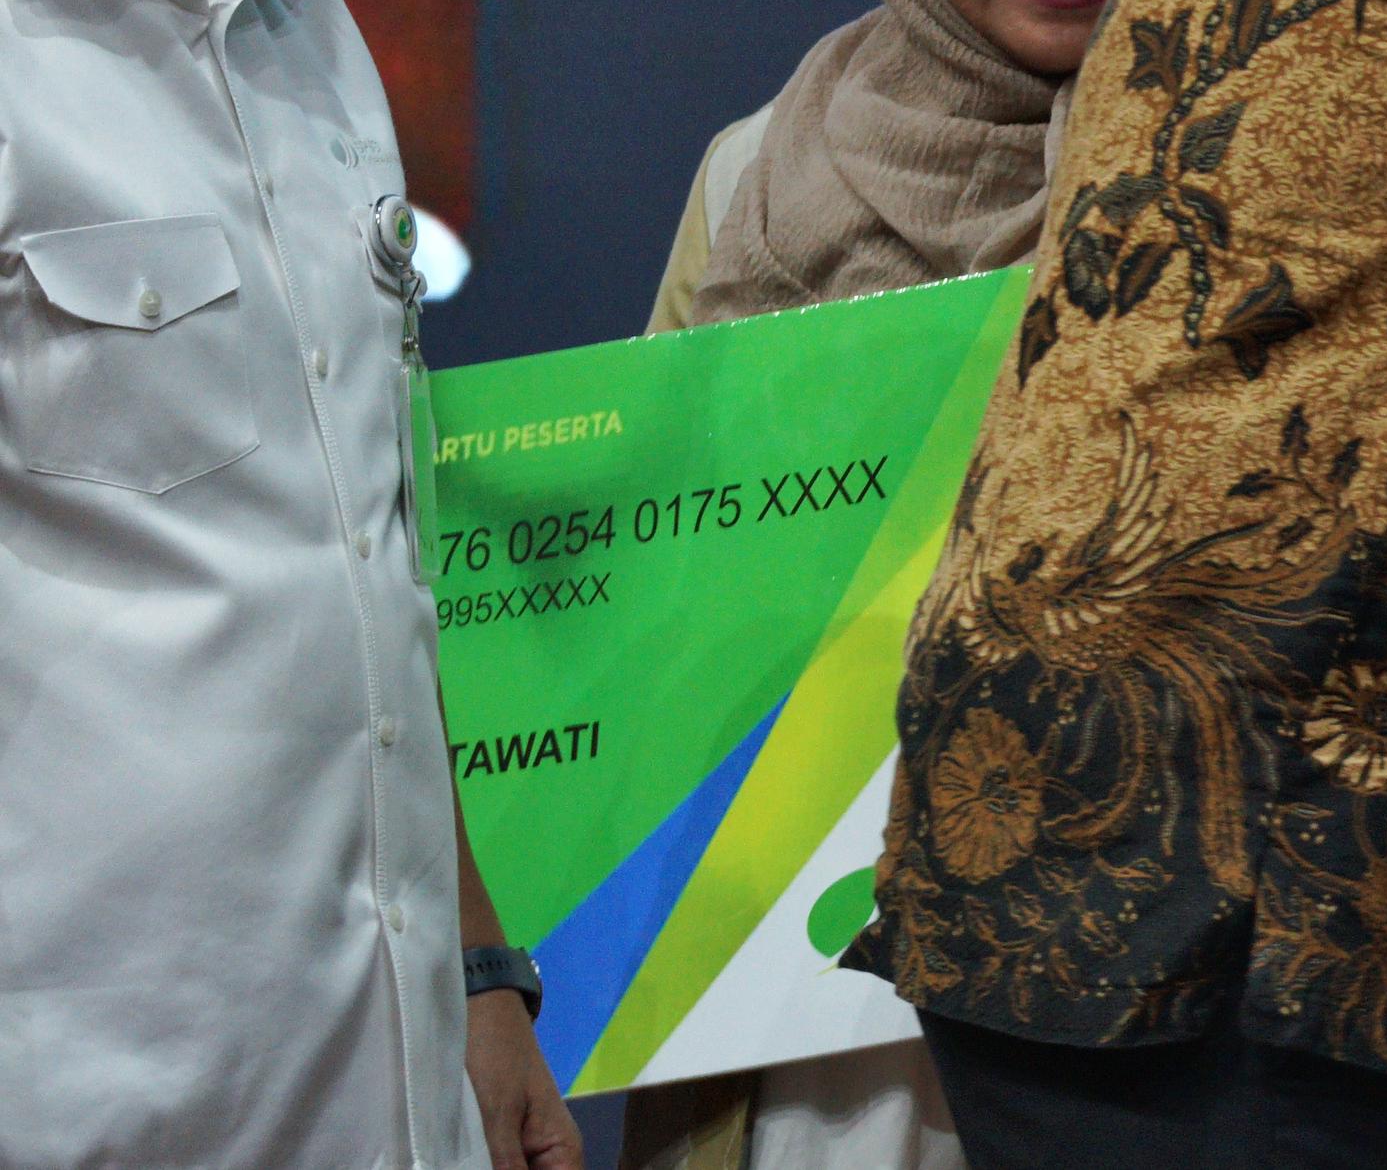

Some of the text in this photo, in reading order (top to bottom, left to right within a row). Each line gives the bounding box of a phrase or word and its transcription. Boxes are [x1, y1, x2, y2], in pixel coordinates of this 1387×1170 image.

[503, 410, 624, 453] PESERTA
[506, 505, 617, 566] 0254
[632, 483, 743, 544] 0175
[756, 455, 889, 523] XXXX
